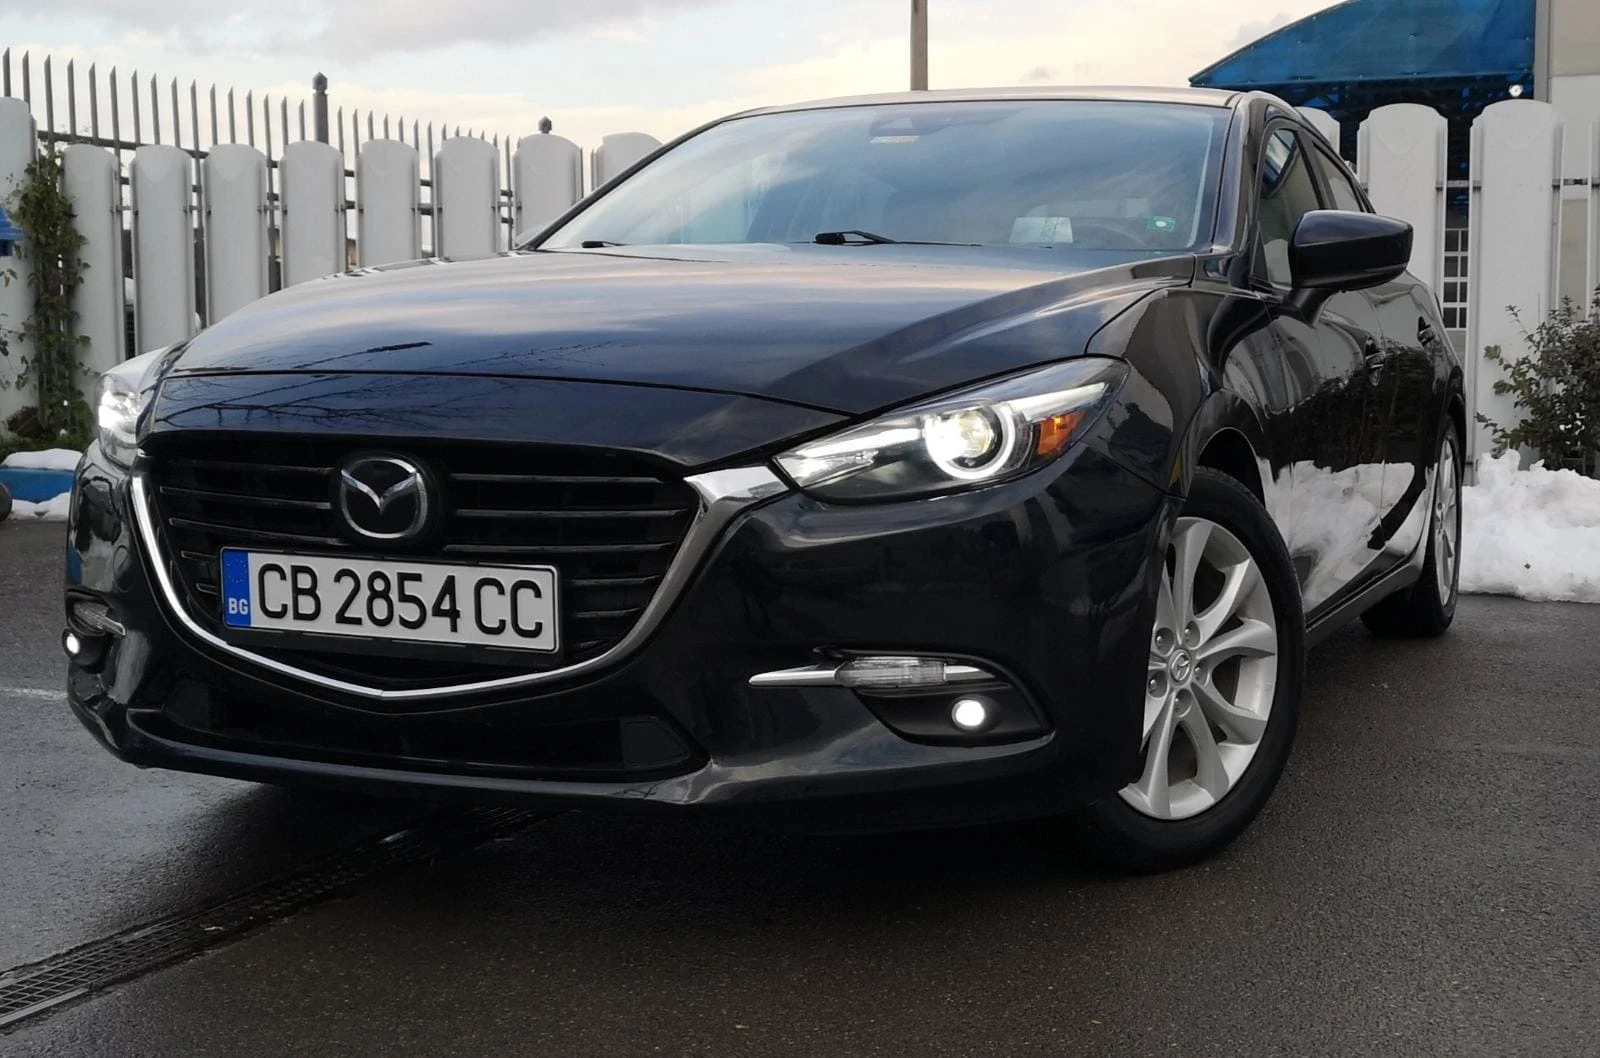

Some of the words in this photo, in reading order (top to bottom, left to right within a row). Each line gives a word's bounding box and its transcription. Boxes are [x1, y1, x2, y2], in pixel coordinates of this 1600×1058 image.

[227, 597, 249, 615] BG
[257, 563, 322, 622] CB
[333, 568, 461, 634] 2854
[473, 577, 543, 639] CC
